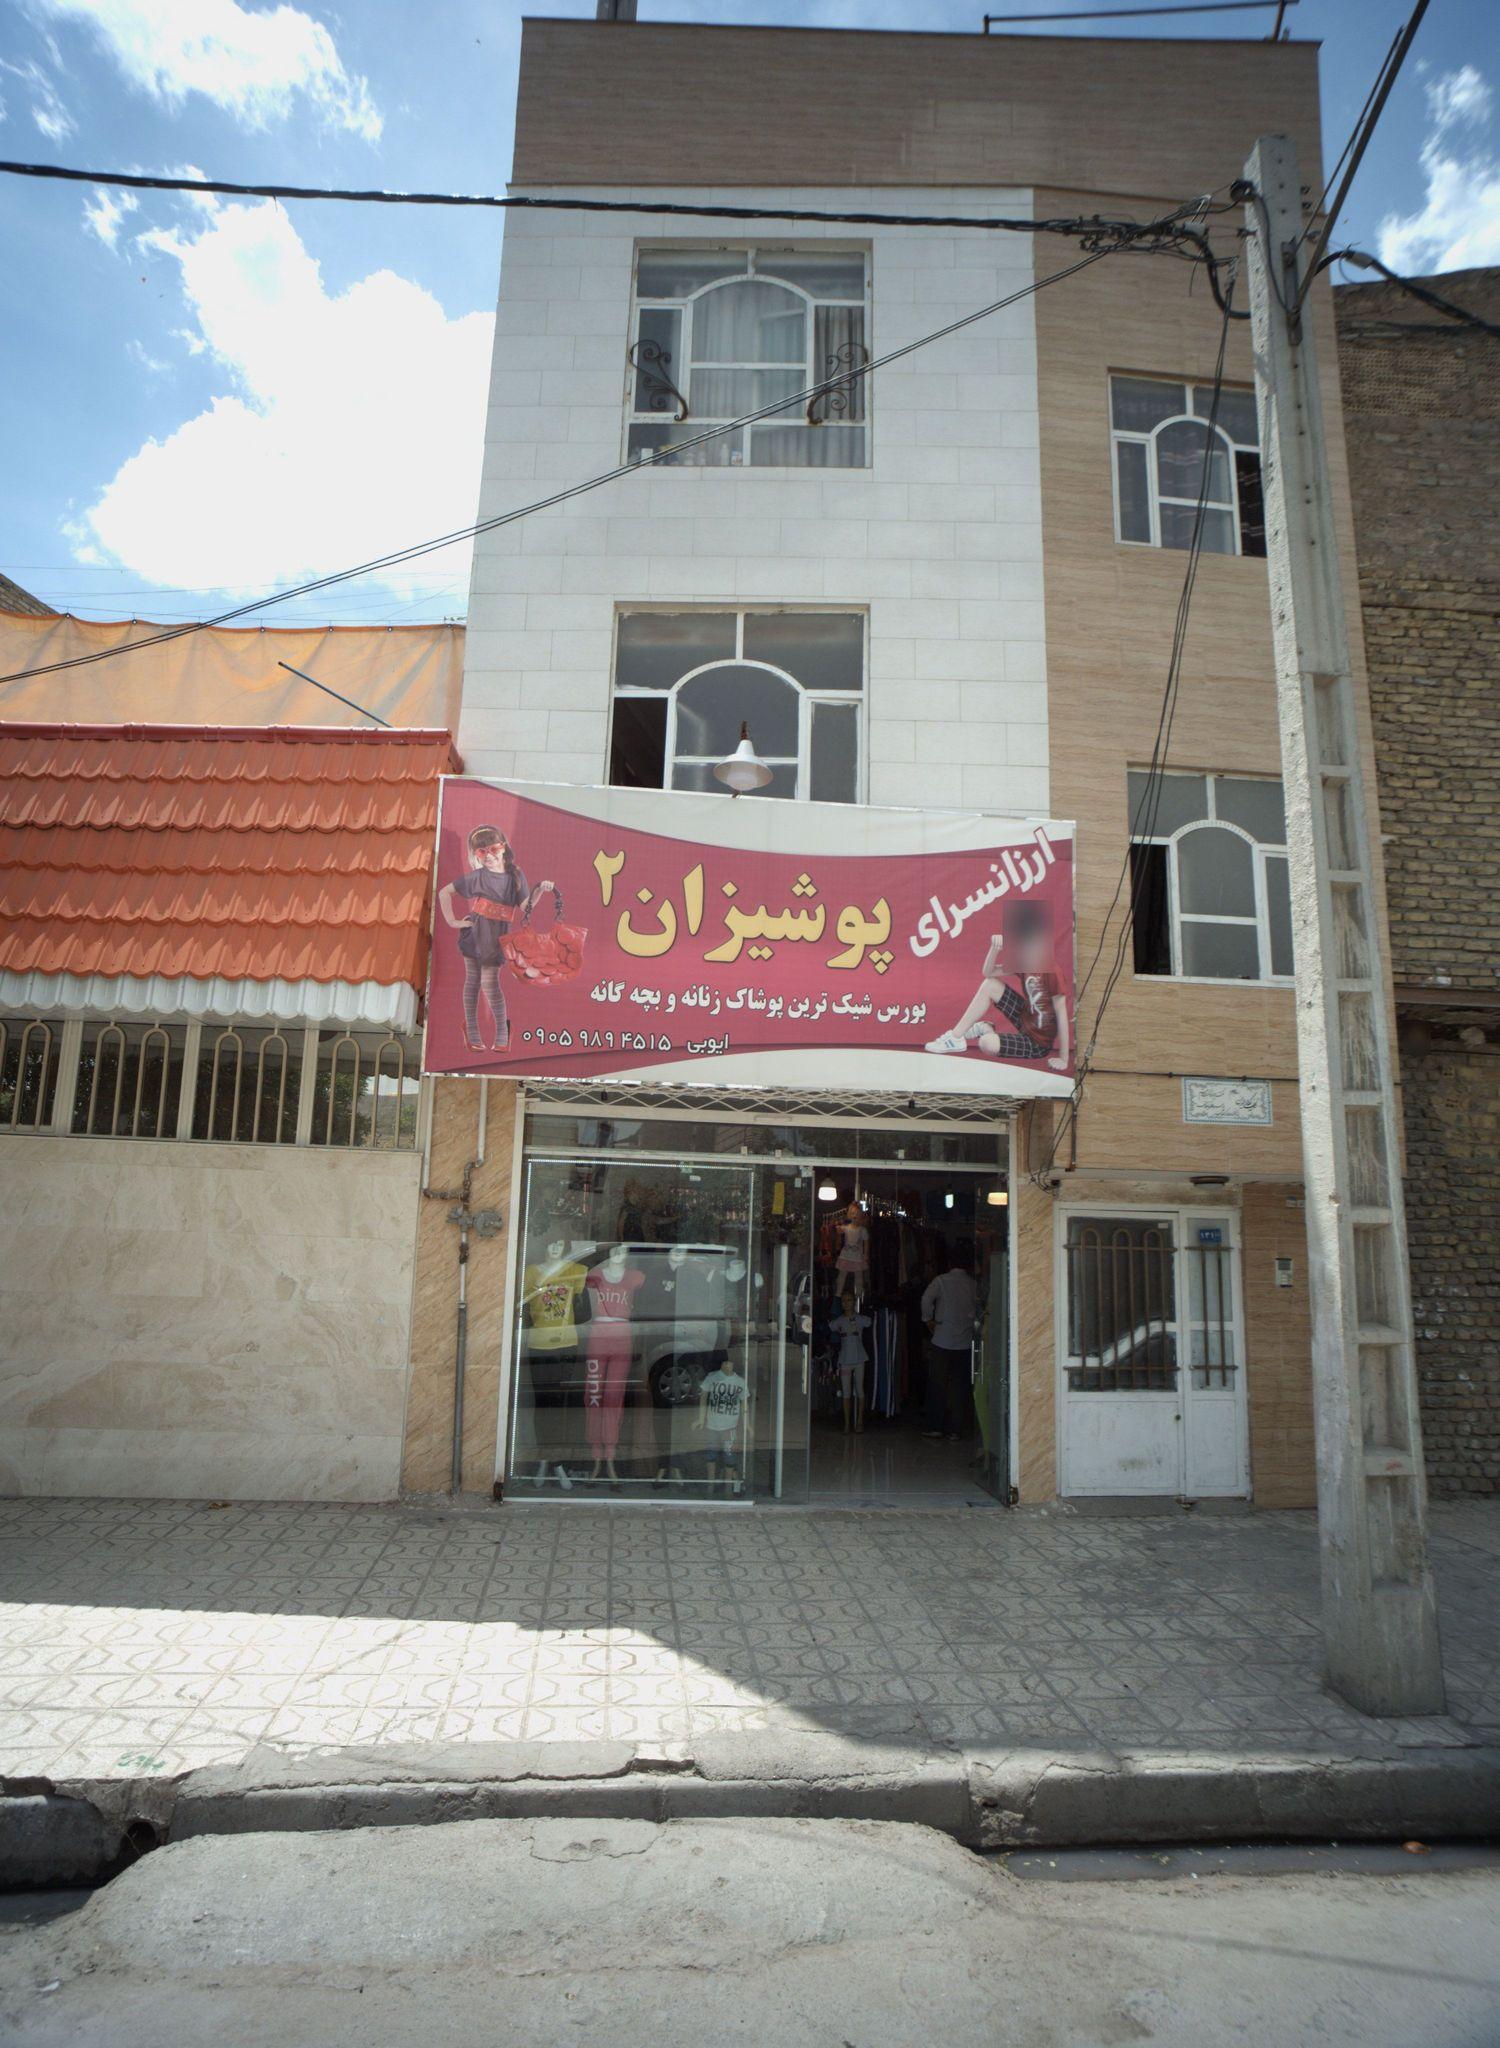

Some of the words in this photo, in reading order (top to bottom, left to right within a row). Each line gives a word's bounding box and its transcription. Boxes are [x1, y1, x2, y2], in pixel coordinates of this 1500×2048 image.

[908, 826, 1056, 958] ارزانسرای
[617, 863, 894, 975] پوشیزان
[589, 980, 626, 1003] گانه
[629, 986, 661, 1012] بچه
[664, 992, 677, 1013] و
[680, 984, 721, 1015] زنانه
[725, 987, 784, 1019] پوشاک
[787, 991, 828, 1020] ترین
[831, 993, 873, 1020] شیک
[876, 1001, 927, 1024] بورس
[521, 1027, 574, 1046] ۰۹۰۵
[578, 1030, 615, 1048] ۹۸۹
[620, 1031, 673, 1052] ۴۵۱۵
[686, 1033, 730, 1055] ایوبی
[596, 1288, 629, 1306] pink
[586, 1359, 602, 1408] pink
